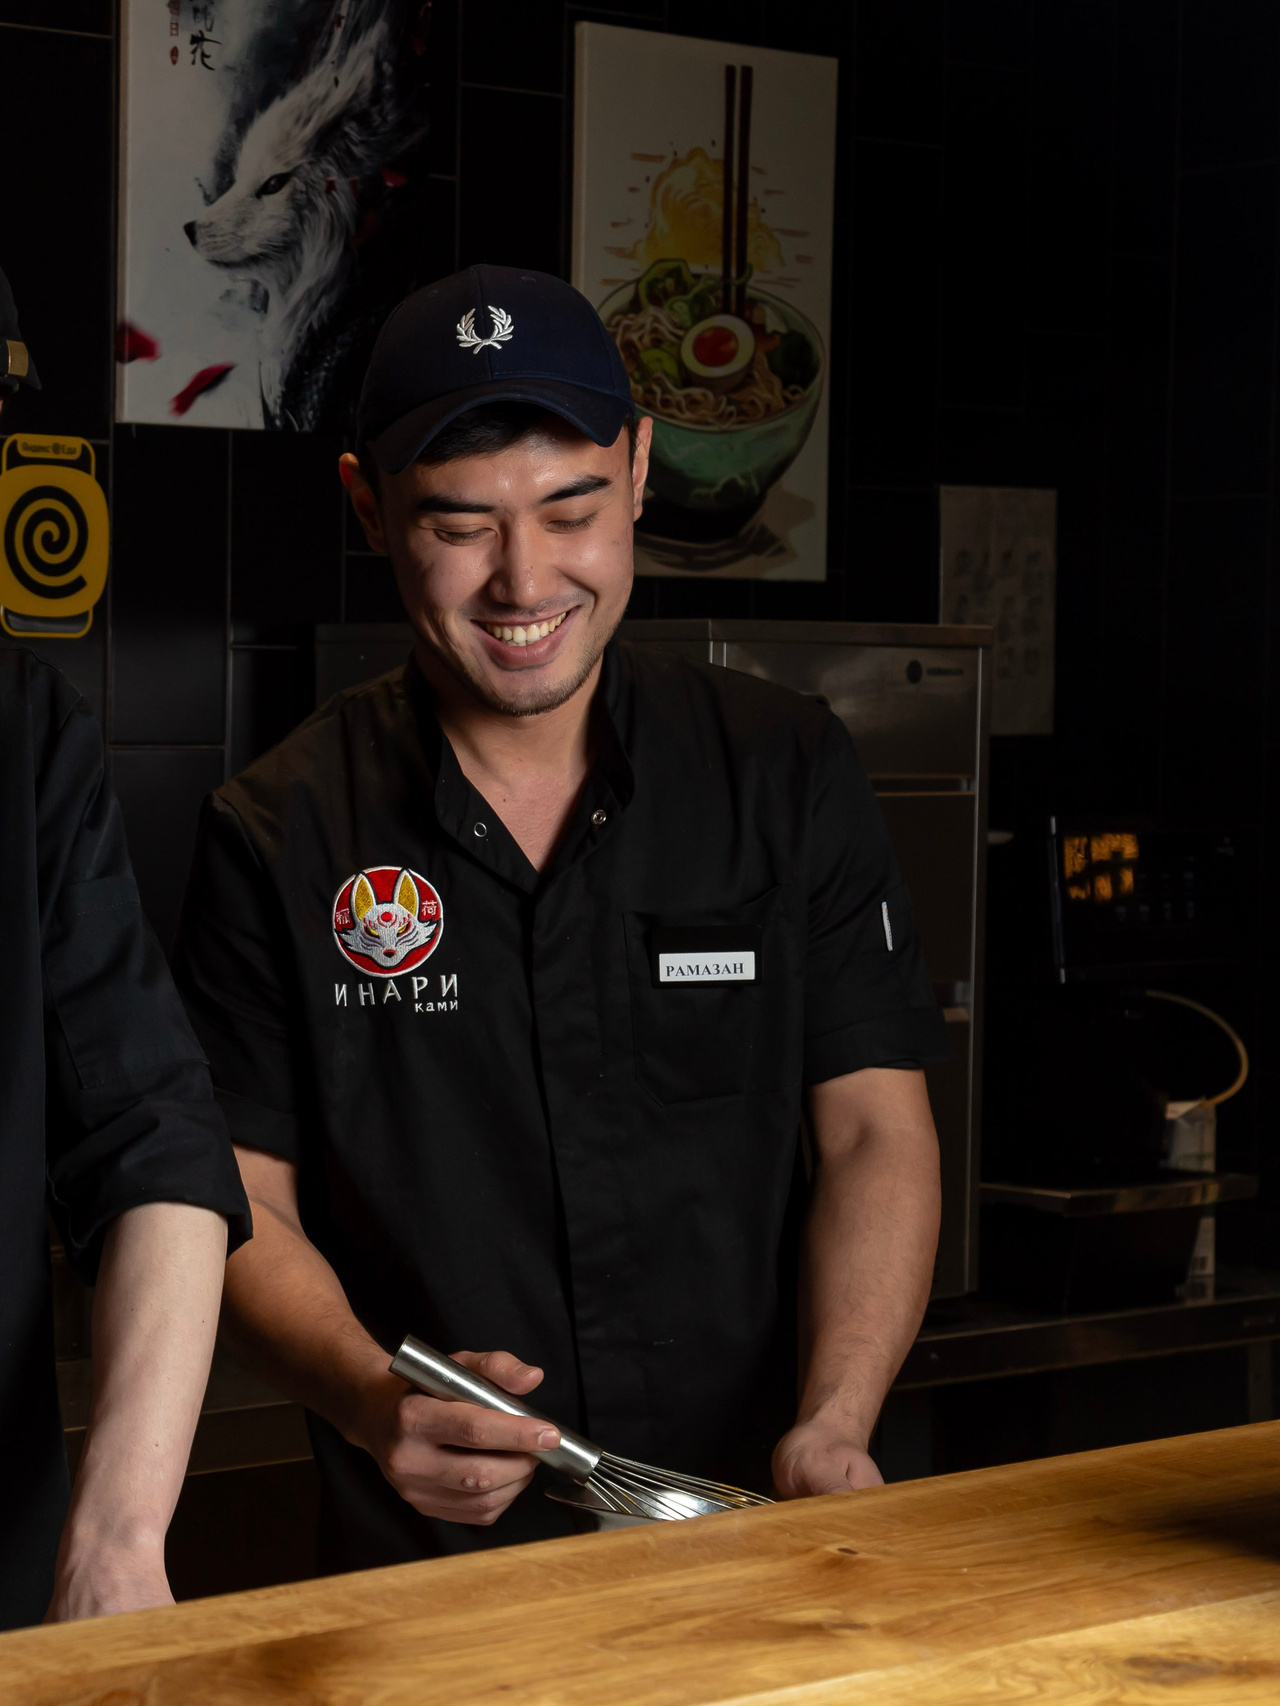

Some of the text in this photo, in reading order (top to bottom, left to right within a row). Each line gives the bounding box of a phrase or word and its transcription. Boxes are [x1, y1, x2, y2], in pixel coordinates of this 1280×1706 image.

[665, 962, 744, 977] РАМАЗАН
[334, 973, 458, 1007] ИНАРИ
[414, 999, 459, 1013] ками
